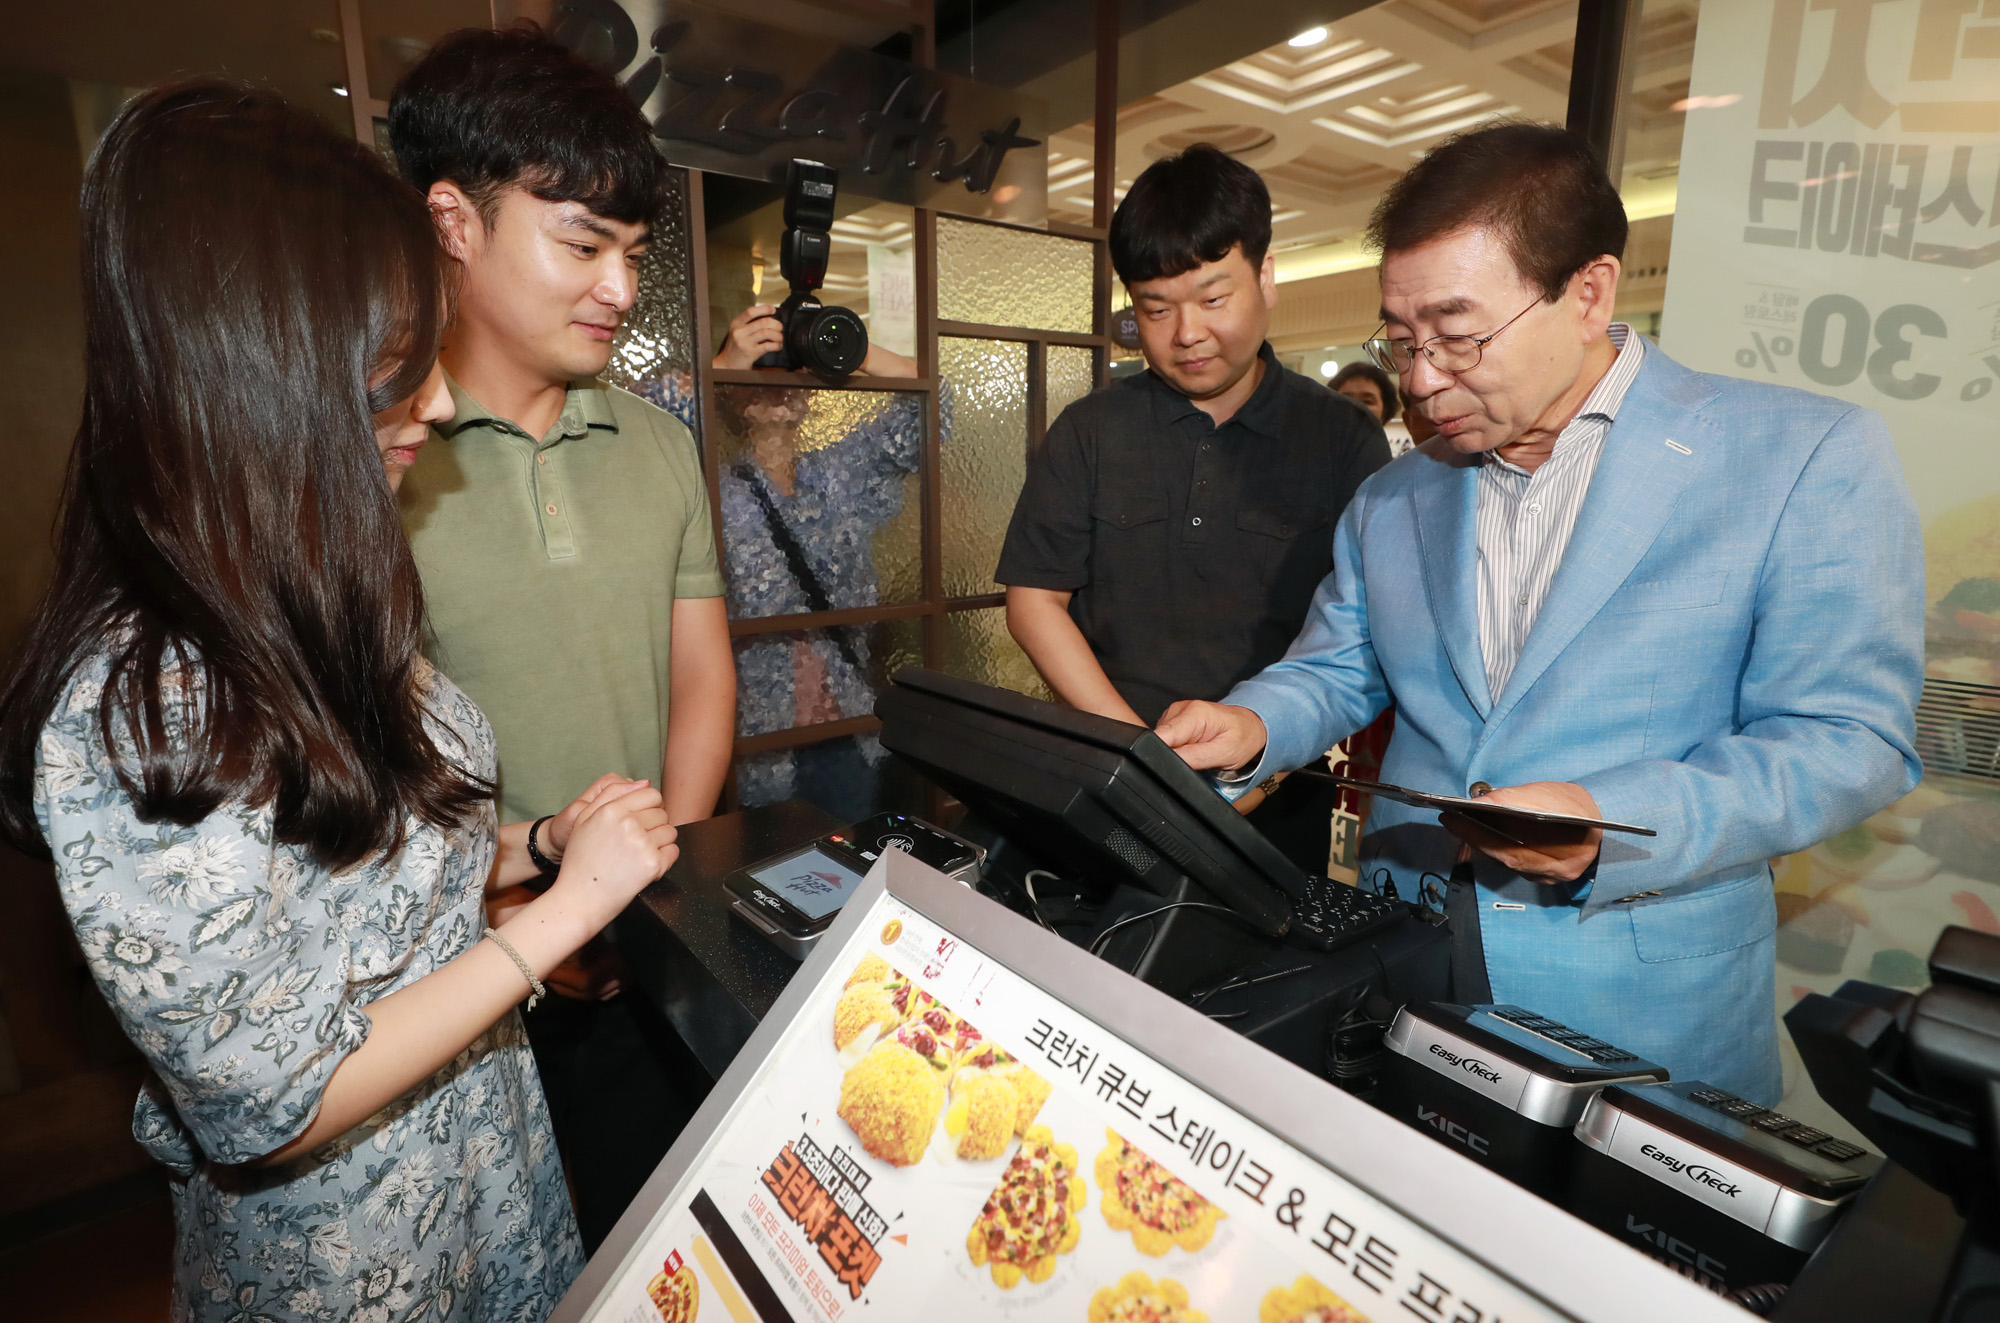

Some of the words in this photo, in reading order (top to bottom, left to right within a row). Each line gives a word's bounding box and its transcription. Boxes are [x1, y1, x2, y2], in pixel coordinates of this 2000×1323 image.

[858, 74, 1042, 194] Hut
[785, 883, 821, 896] Hut
[790, 874, 833, 894] Pizza
[1024, 1018, 1099, 1085] 크런치
[1098, 1063, 1151, 1120] 큐브
[1148, 1106, 1274, 1206] 스테이크
[1276, 1188, 1306, 1234] &
[1311, 1213, 1399, 1295] 모든
[1417, 1104, 1490, 1156] KICC
[795, 1137, 842, 1196] 3.5초마다
[834, 1180, 864, 1221] 판매
[854, 1205, 886, 1247] 신화
[747, 1193, 768, 1220] 이제
[760, 1211, 781, 1239] 모든
[775, 1230, 810, 1278] 프리미엄
[817, 1213, 882, 1301] 포켓
[1626, 1213, 1727, 1282] KICC
